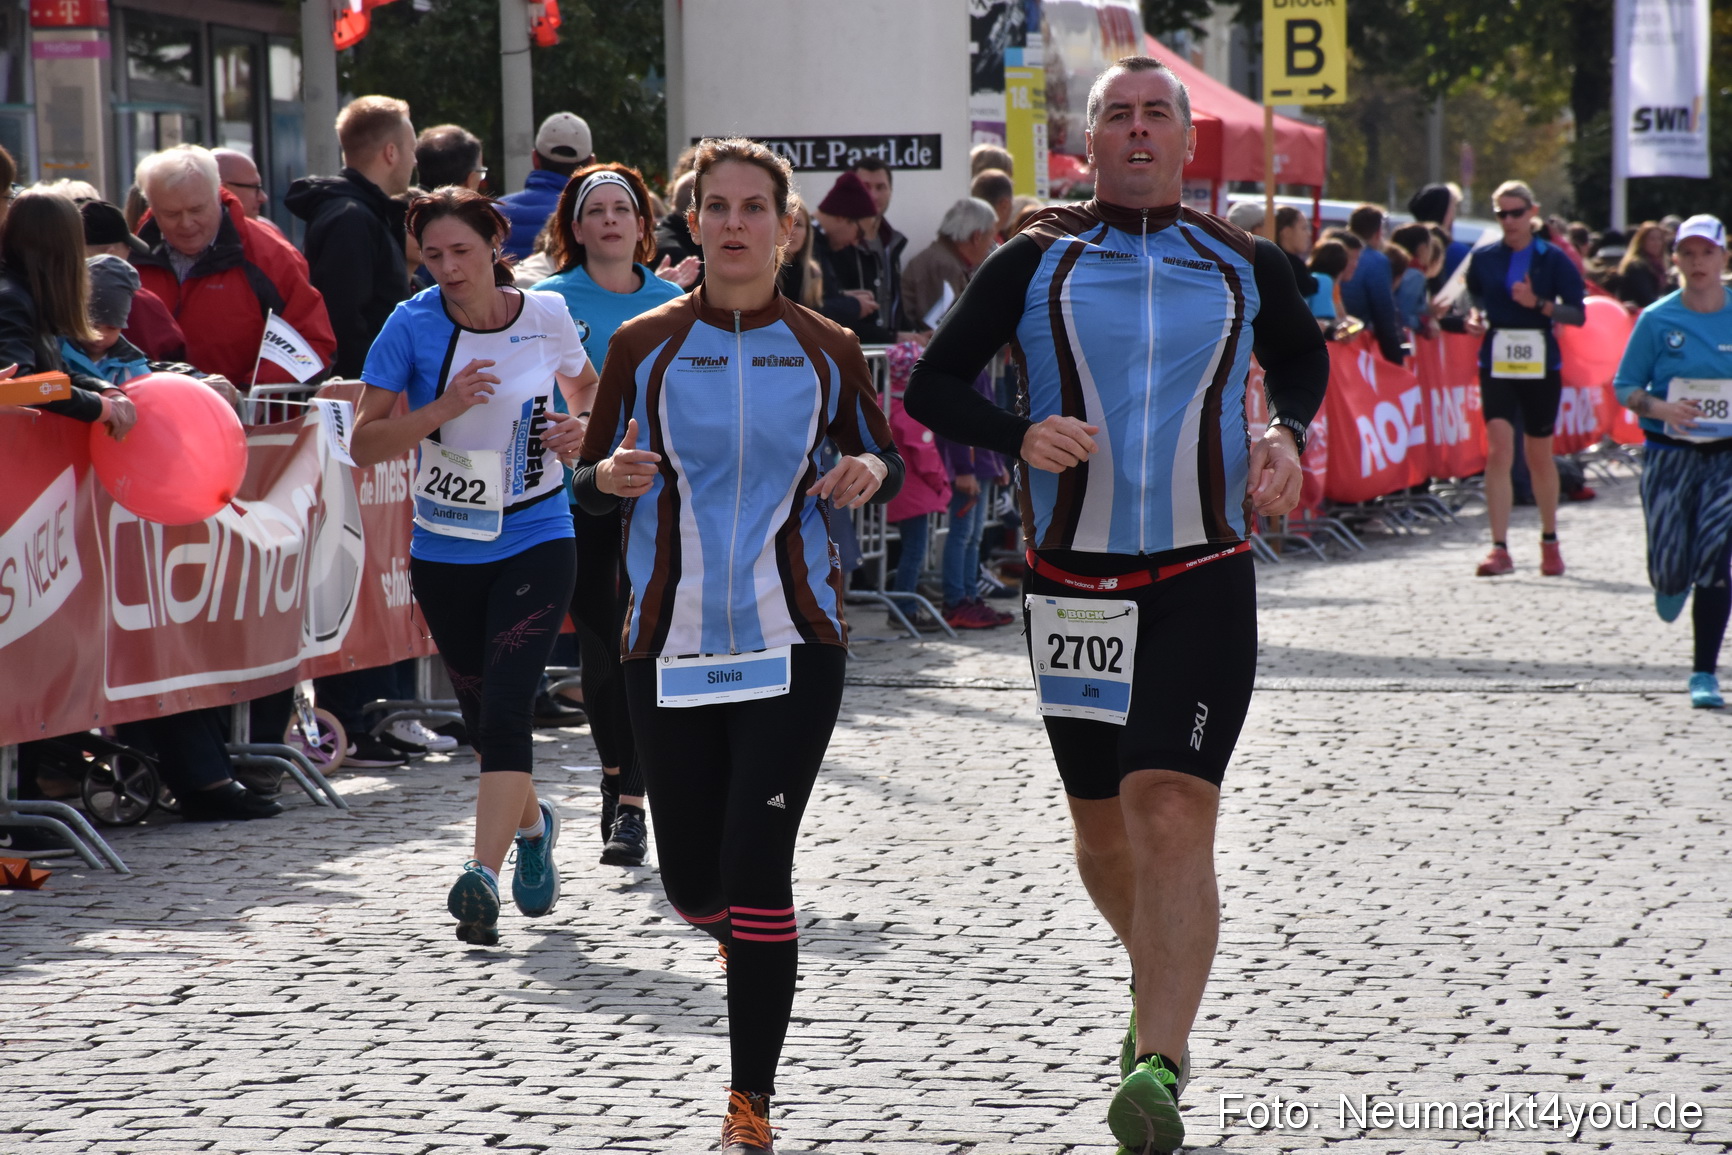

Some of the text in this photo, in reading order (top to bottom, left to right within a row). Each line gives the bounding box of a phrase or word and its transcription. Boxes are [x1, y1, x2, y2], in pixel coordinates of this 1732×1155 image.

[1286, 18, 1325, 77] B
[1505, 345, 1532, 360] 188
[779, 356, 805, 367] RACER
[513, 416, 529, 492] TECHNOLOGY
[424, 466, 487, 505] 2422
[433, 508, 469, 521] Andrea
[24, 500, 69, 609] NEUE
[1074, 580, 1095, 590] balance
[1066, 609, 1105, 620] BOCK
[1047, 633, 1124, 674] 2702
[707, 669, 743, 684] Silvia
[1082, 684, 1100, 699] Jim
[1189, 701, 1209, 752] 2XU
[767, 800, 786, 810] adidas
